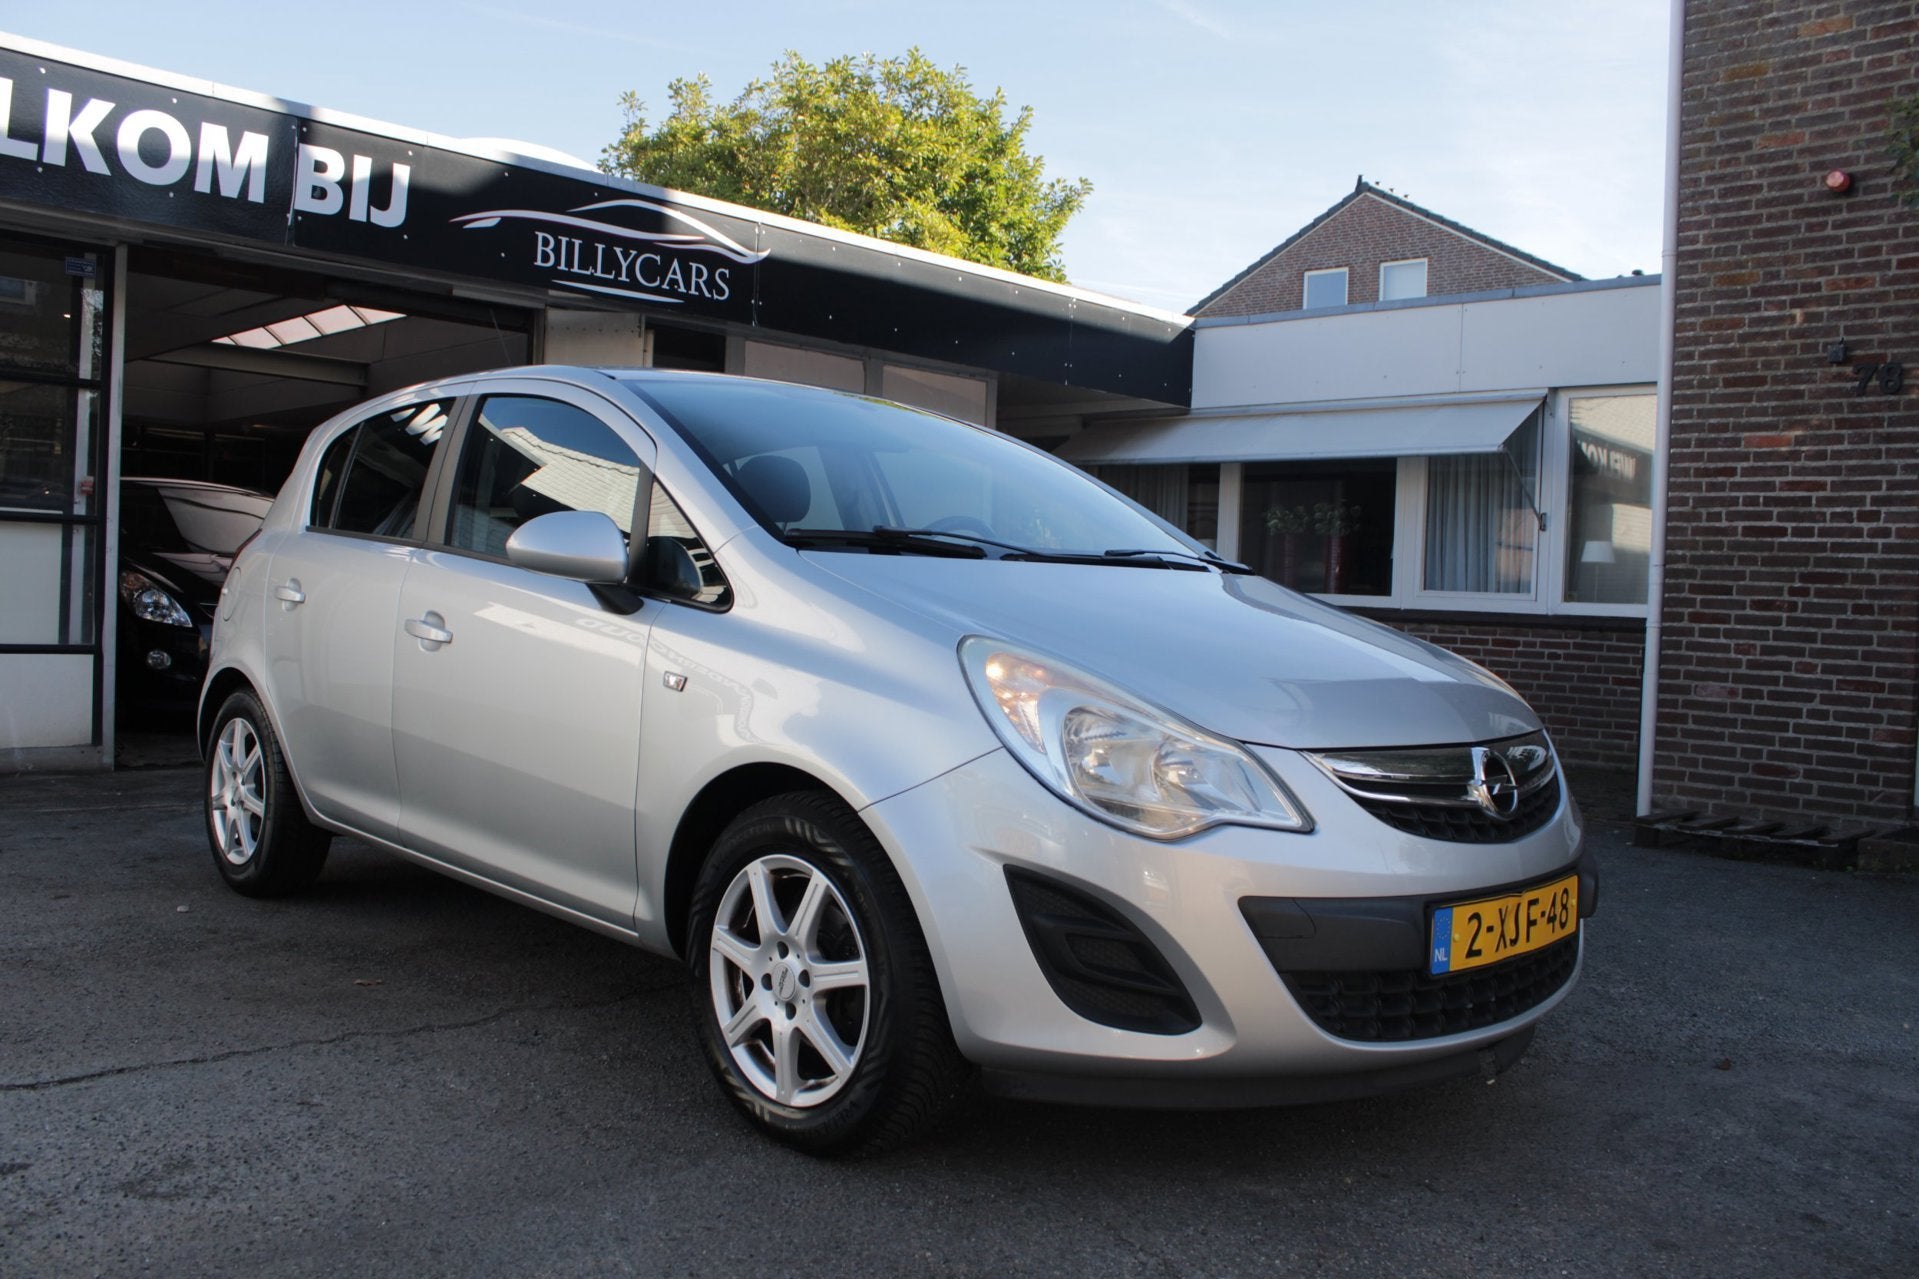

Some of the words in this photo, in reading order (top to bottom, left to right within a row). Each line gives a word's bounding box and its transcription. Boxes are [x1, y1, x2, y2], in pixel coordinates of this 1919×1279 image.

[294, 143, 411, 228] BIJ
[534, 231, 730, 301] BILLYCARS
[1852, 362, 1903, 397] 78
[1434, 947, 1448, 962] NL
